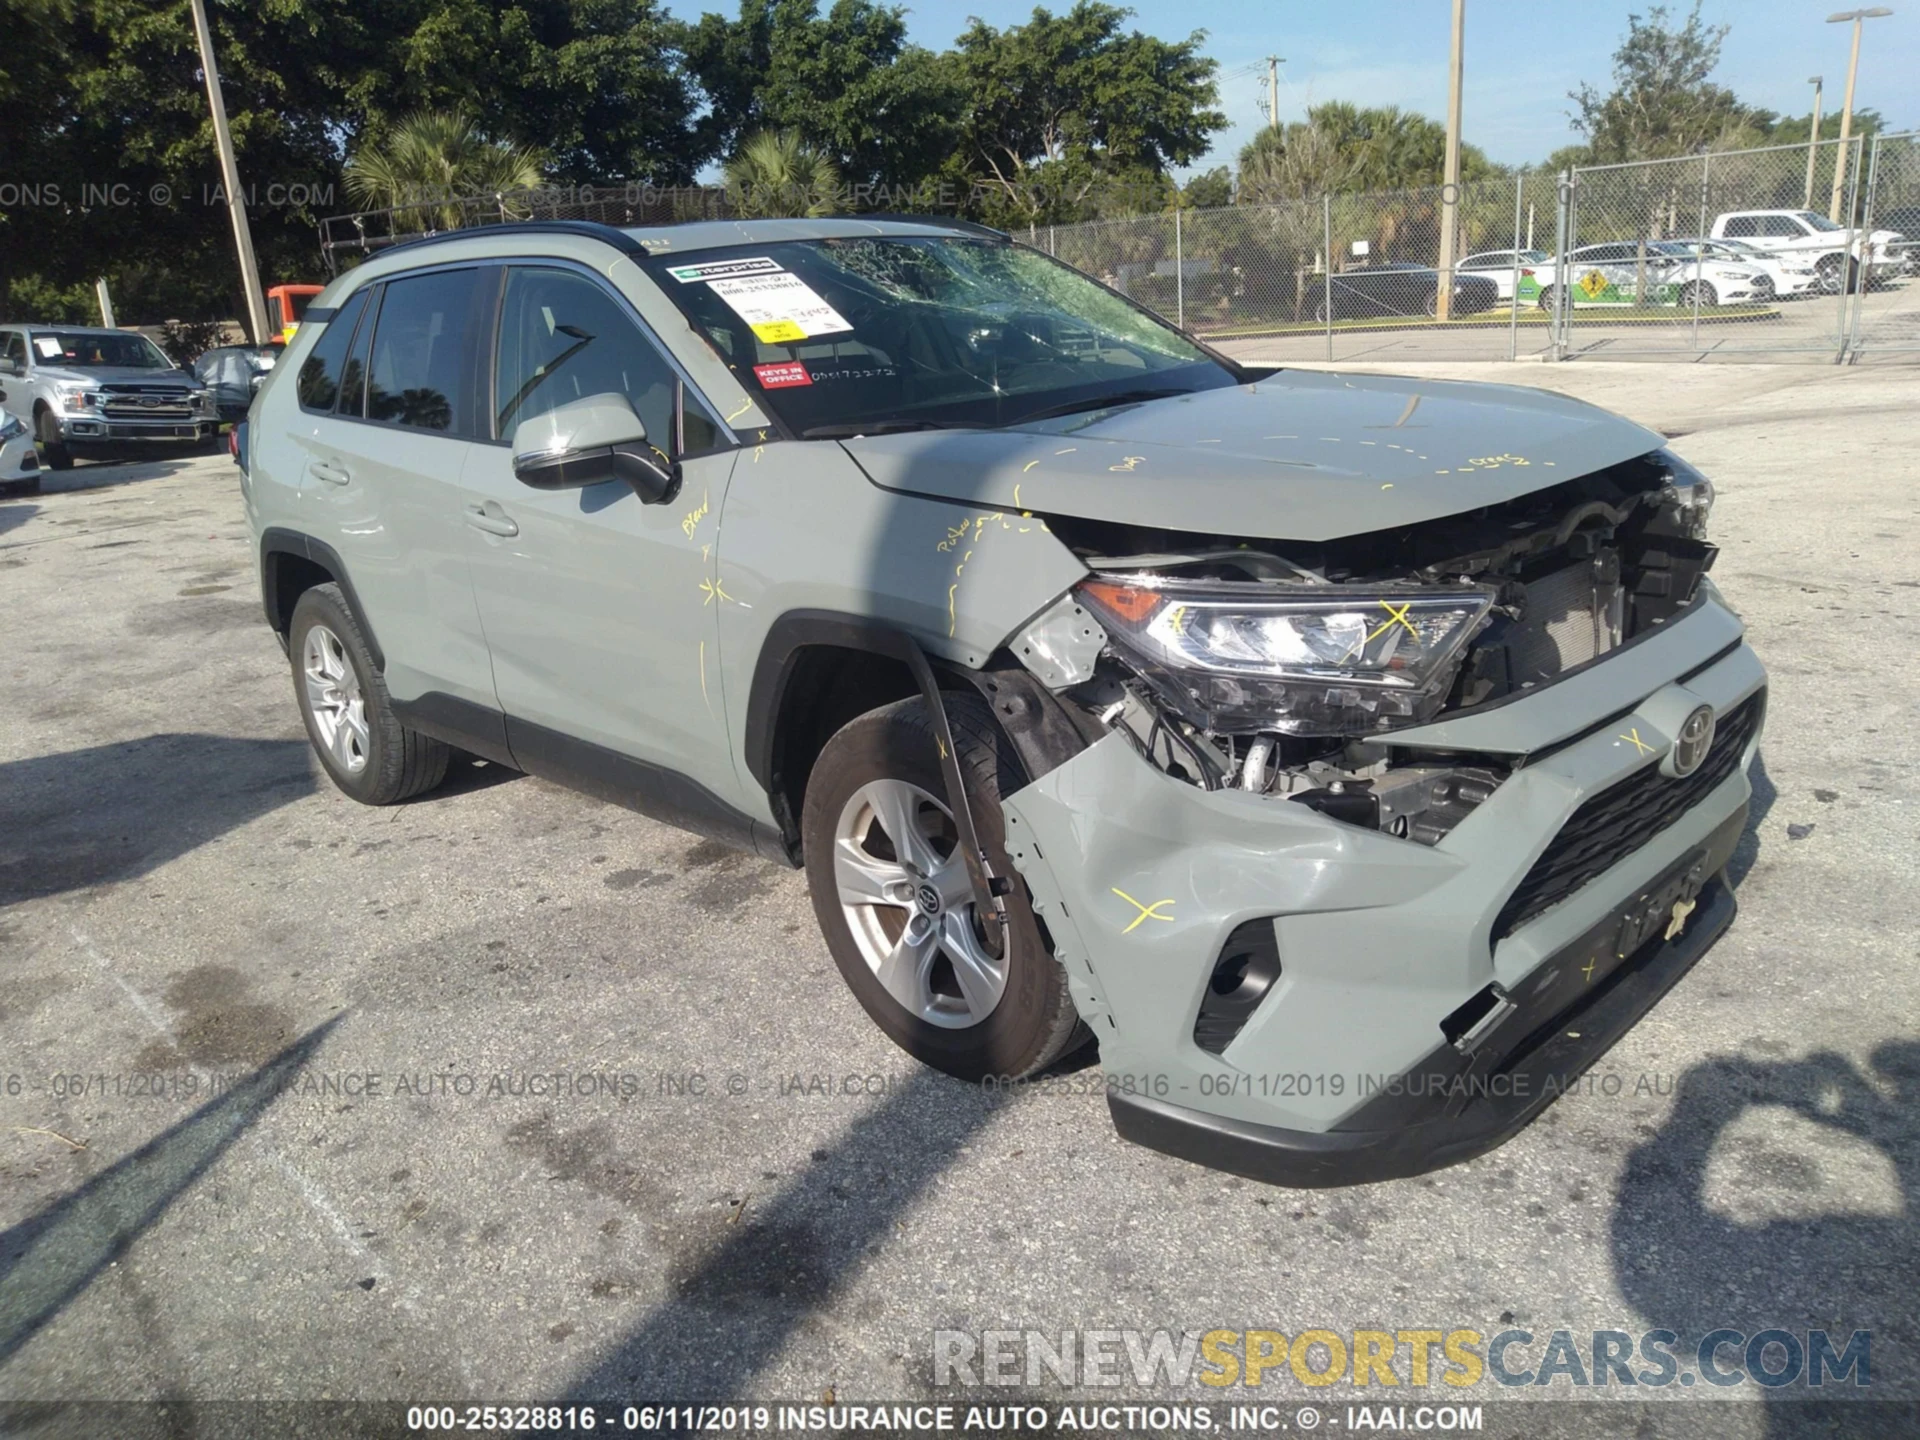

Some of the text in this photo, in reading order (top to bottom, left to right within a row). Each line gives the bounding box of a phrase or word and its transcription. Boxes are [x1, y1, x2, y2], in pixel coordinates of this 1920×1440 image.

[676, 261, 773, 278] enterprise
[1618, 284, 1669, 296] GECO
[759, 366, 803, 378] KEYS IN
[765, 374, 805, 384] OFFICE
